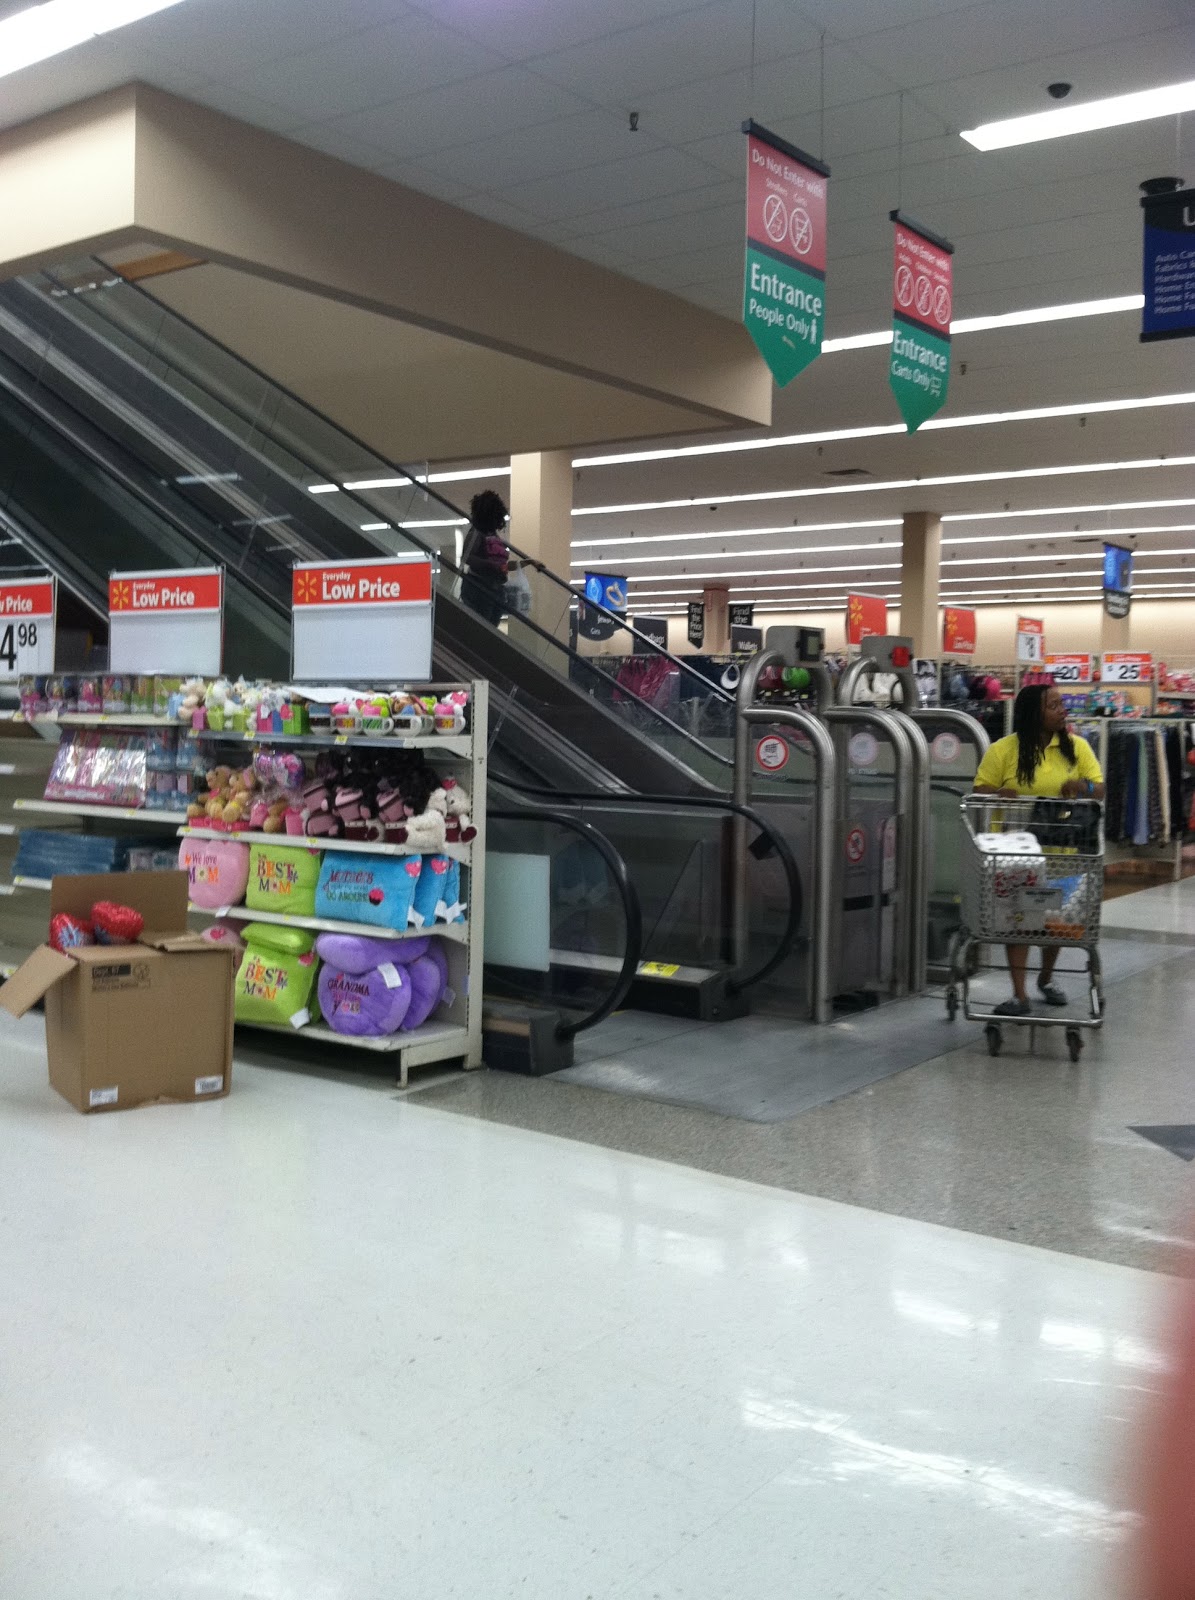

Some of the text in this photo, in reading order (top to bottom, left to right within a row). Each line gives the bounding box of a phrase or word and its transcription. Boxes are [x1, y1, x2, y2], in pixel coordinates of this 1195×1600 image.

[752, 148, 765, 167] Do
[766, 156, 782, 177] Not
[783, 165, 804, 188] Enter
[750, 262, 822, 317] Entrance
[749, 297, 810, 341] People Only
[893, 328, 947, 373] Entrance
[912, 368, 930, 391] Only
[322, 571, 351, 582] Everyday
[322, 576, 400, 601] Low Price
[6, 594, 33, 613] Price
[132, 586, 195, 608] Low Price
[1118, 664, 1140, 680] 25
[257, 858, 295, 881] BEST
[246, 961, 288, 988] BEST
